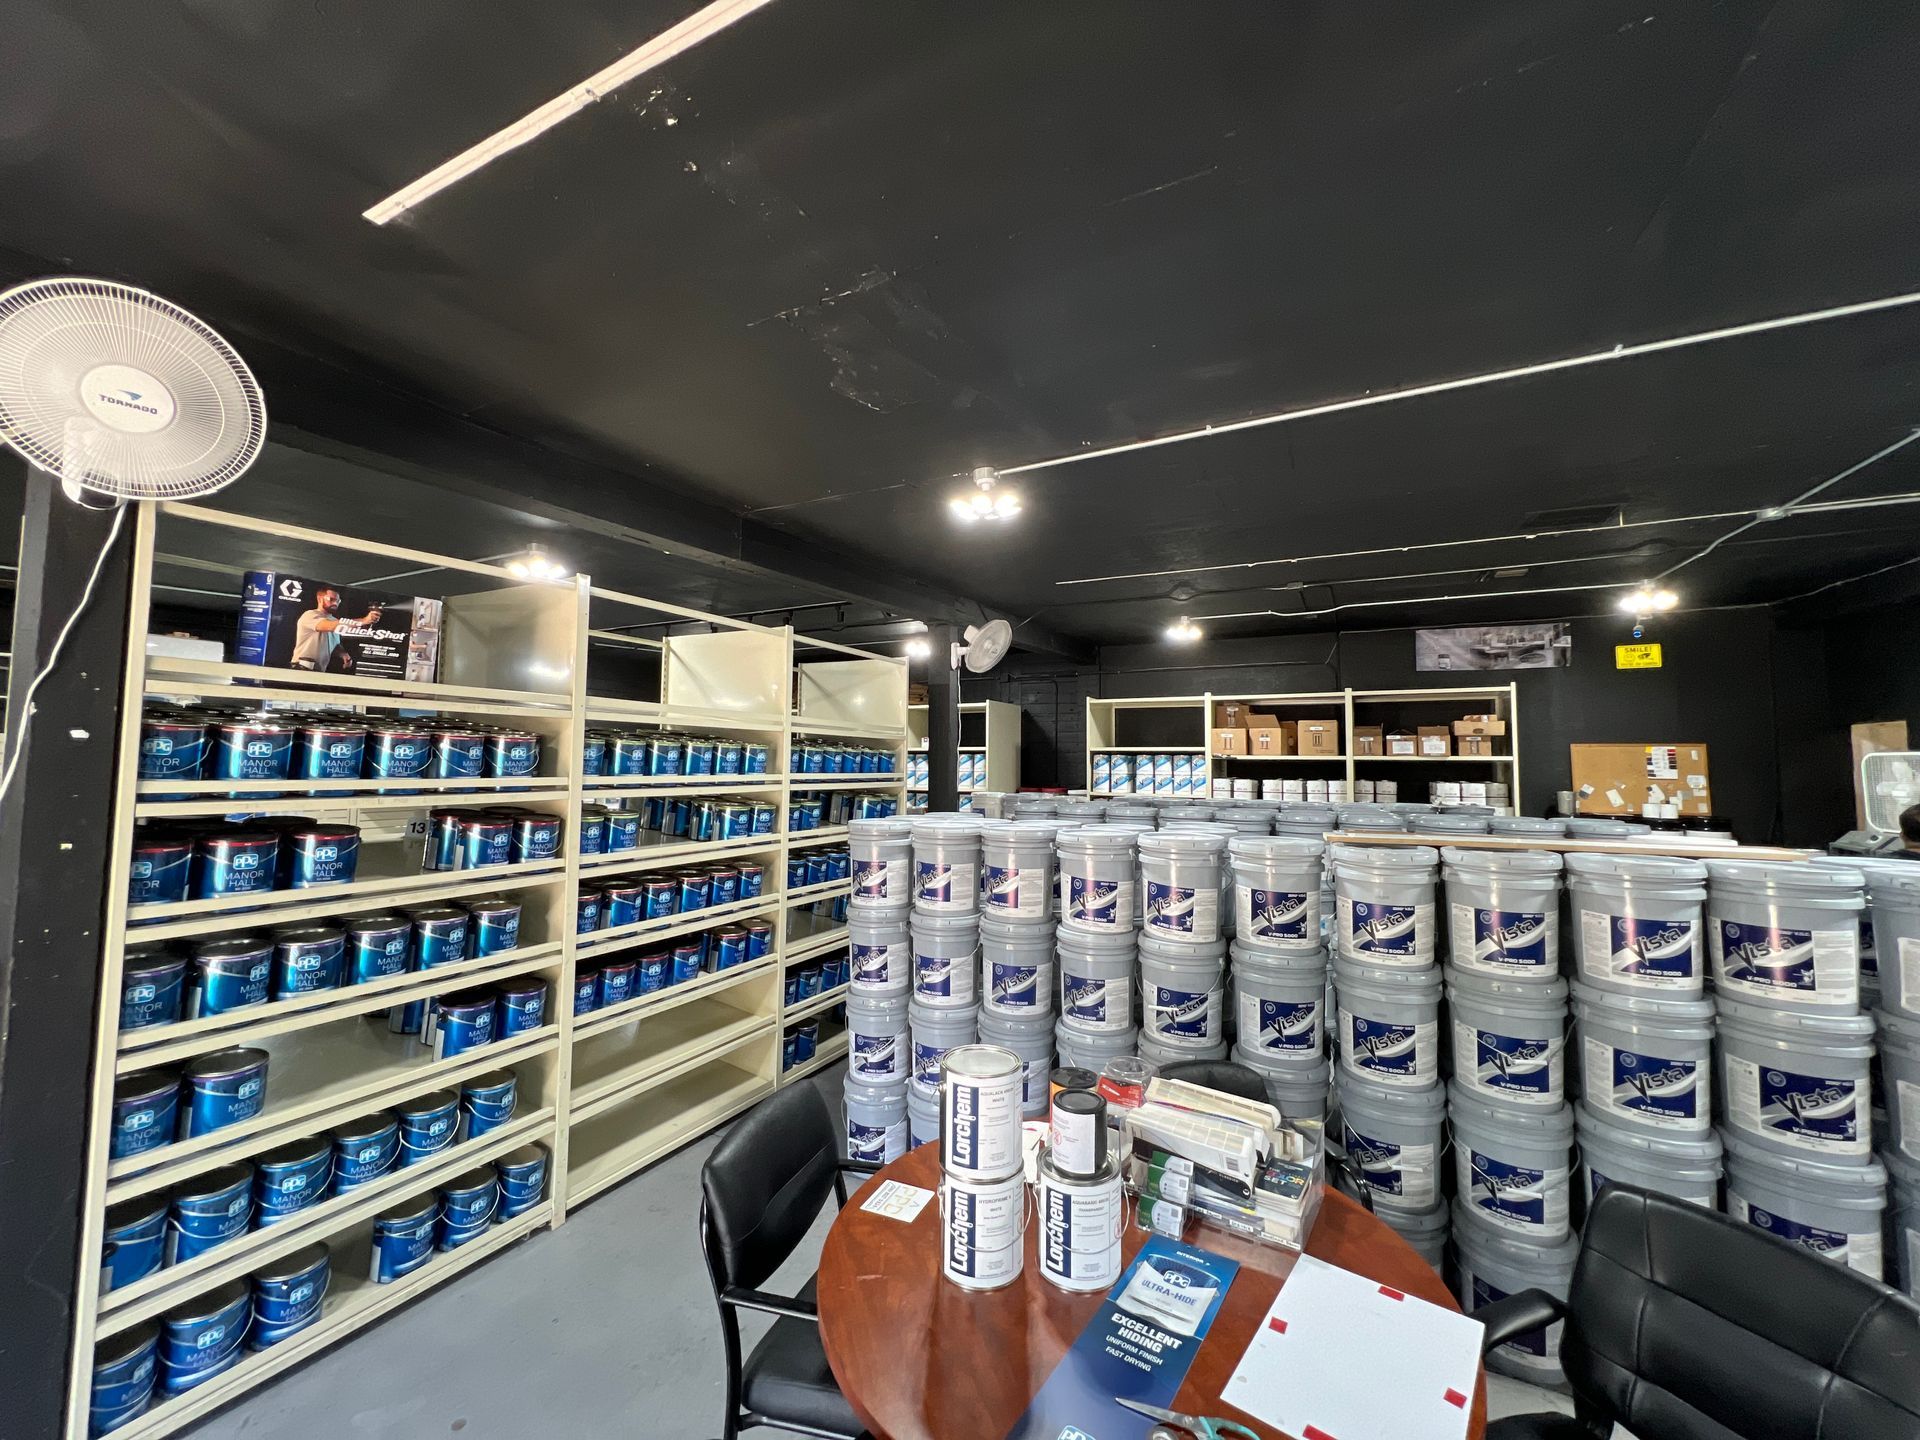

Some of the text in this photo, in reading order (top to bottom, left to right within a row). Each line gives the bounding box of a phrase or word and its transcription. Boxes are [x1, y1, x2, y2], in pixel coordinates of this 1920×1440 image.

[98, 393, 158, 415] TORNADO
[339, 617, 363, 627] Ultra
[248, 742, 272, 757] PPG
[330, 743, 352, 758] PPG
[394, 745, 414, 759] PPG
[510, 747, 527, 759] PPG
[239, 759, 278, 767] MANOR
[242, 766, 271, 775] HALL
[320, 760, 355, 768] MANOR
[326, 766, 350, 775] HALL
[410, 822, 426, 834] 13
[534, 830, 550, 843] PPG
[493, 833, 508, 847] PPG
[233, 854, 259, 869] PPG
[316, 847, 338, 861] PPG
[224, 869, 264, 881] MANOR
[312, 869, 336, 878] HALL
[228, 879, 257, 887] HALL
[658, 891, 671, 904] PPG
[1074, 885, 1110, 915] Vista
[1150, 891, 1186, 921] Vista
[1258, 898, 1299, 931] Vista
[506, 919, 519, 933] PPG
[1267, 930, 1282, 938] V-PRO
[1359, 911, 1406, 946] Vista
[449, 928, 465, 943] PPG
[1483, 919, 1537, 956] Vista
[385, 939, 404, 956] PPG
[1370, 946, 1388, 954] V-PRO
[1621, 927, 1682, 967] Vista
[298, 954, 321, 971] PPG
[855, 949, 881, 977] Vista
[1497, 956, 1517, 965] V-PRO
[648, 964, 662, 976] PPG
[1638, 967, 1682, 977] V-PRO 5000
[294, 978, 319, 988] HALL
[612, 975, 626, 988] PPG
[996, 969, 1031, 1000] Vista
[1746, 974, 1798, 988] V-PRO 5000
[125, 984, 156, 1004] PPG
[1067, 981, 1098, 1012] Vista
[524, 999, 540, 1014] PPG
[475, 1012, 491, 1028] PPG
[1268, 1007, 1309, 1042] Vista
[1278, 1042, 1293, 1050] V-PRO
[1359, 1028, 1406, 1064] Vista
[1370, 1063, 1388, 1071] V-PRO
[1486, 1045, 1539, 1081] Vista
[1499, 1081, 1520, 1090] V-PRO
[1623, 1067, 1686, 1104] Vista
[1639, 1103, 1685, 1117] V-PRO 5000
[1771, 1085, 1844, 1127] Vista
[429, 1119, 448, 1137] PPG
[953, 1085, 976, 1166] Lorchem
[1791, 1125, 1844, 1140] V-PRO 5000
[359, 1145, 381, 1164] PPG
[350, 1158, 386, 1175] MANOR
[281, 1175, 307, 1194] PPG
[1480, 1172, 1533, 1206] Vista
[272, 1189, 312, 1206] MANOR
[470, 1196, 488, 1214] PPG
[1491, 1204, 1532, 1221] V-PRO 5000
[950, 1190, 974, 1273] Lorchem
[1046, 1190, 1069, 1273] Lorchem
[1176, 1250, 1204, 1264] INTERIOR
[1164, 1270, 1191, 1288] PPG
[289, 1282, 314, 1305] PPG
[1141, 1279, 1198, 1306] ULTRA-HIDE
[197, 1324, 225, 1350] PPG
[1111, 1312, 1183, 1350] EXCELLENT
[1117, 1326, 1163, 1353] HIDING
[1105, 1334, 1164, 1366] UNIFORM FINISH
[1105, 1345, 1152, 1373] FAST DRYING
